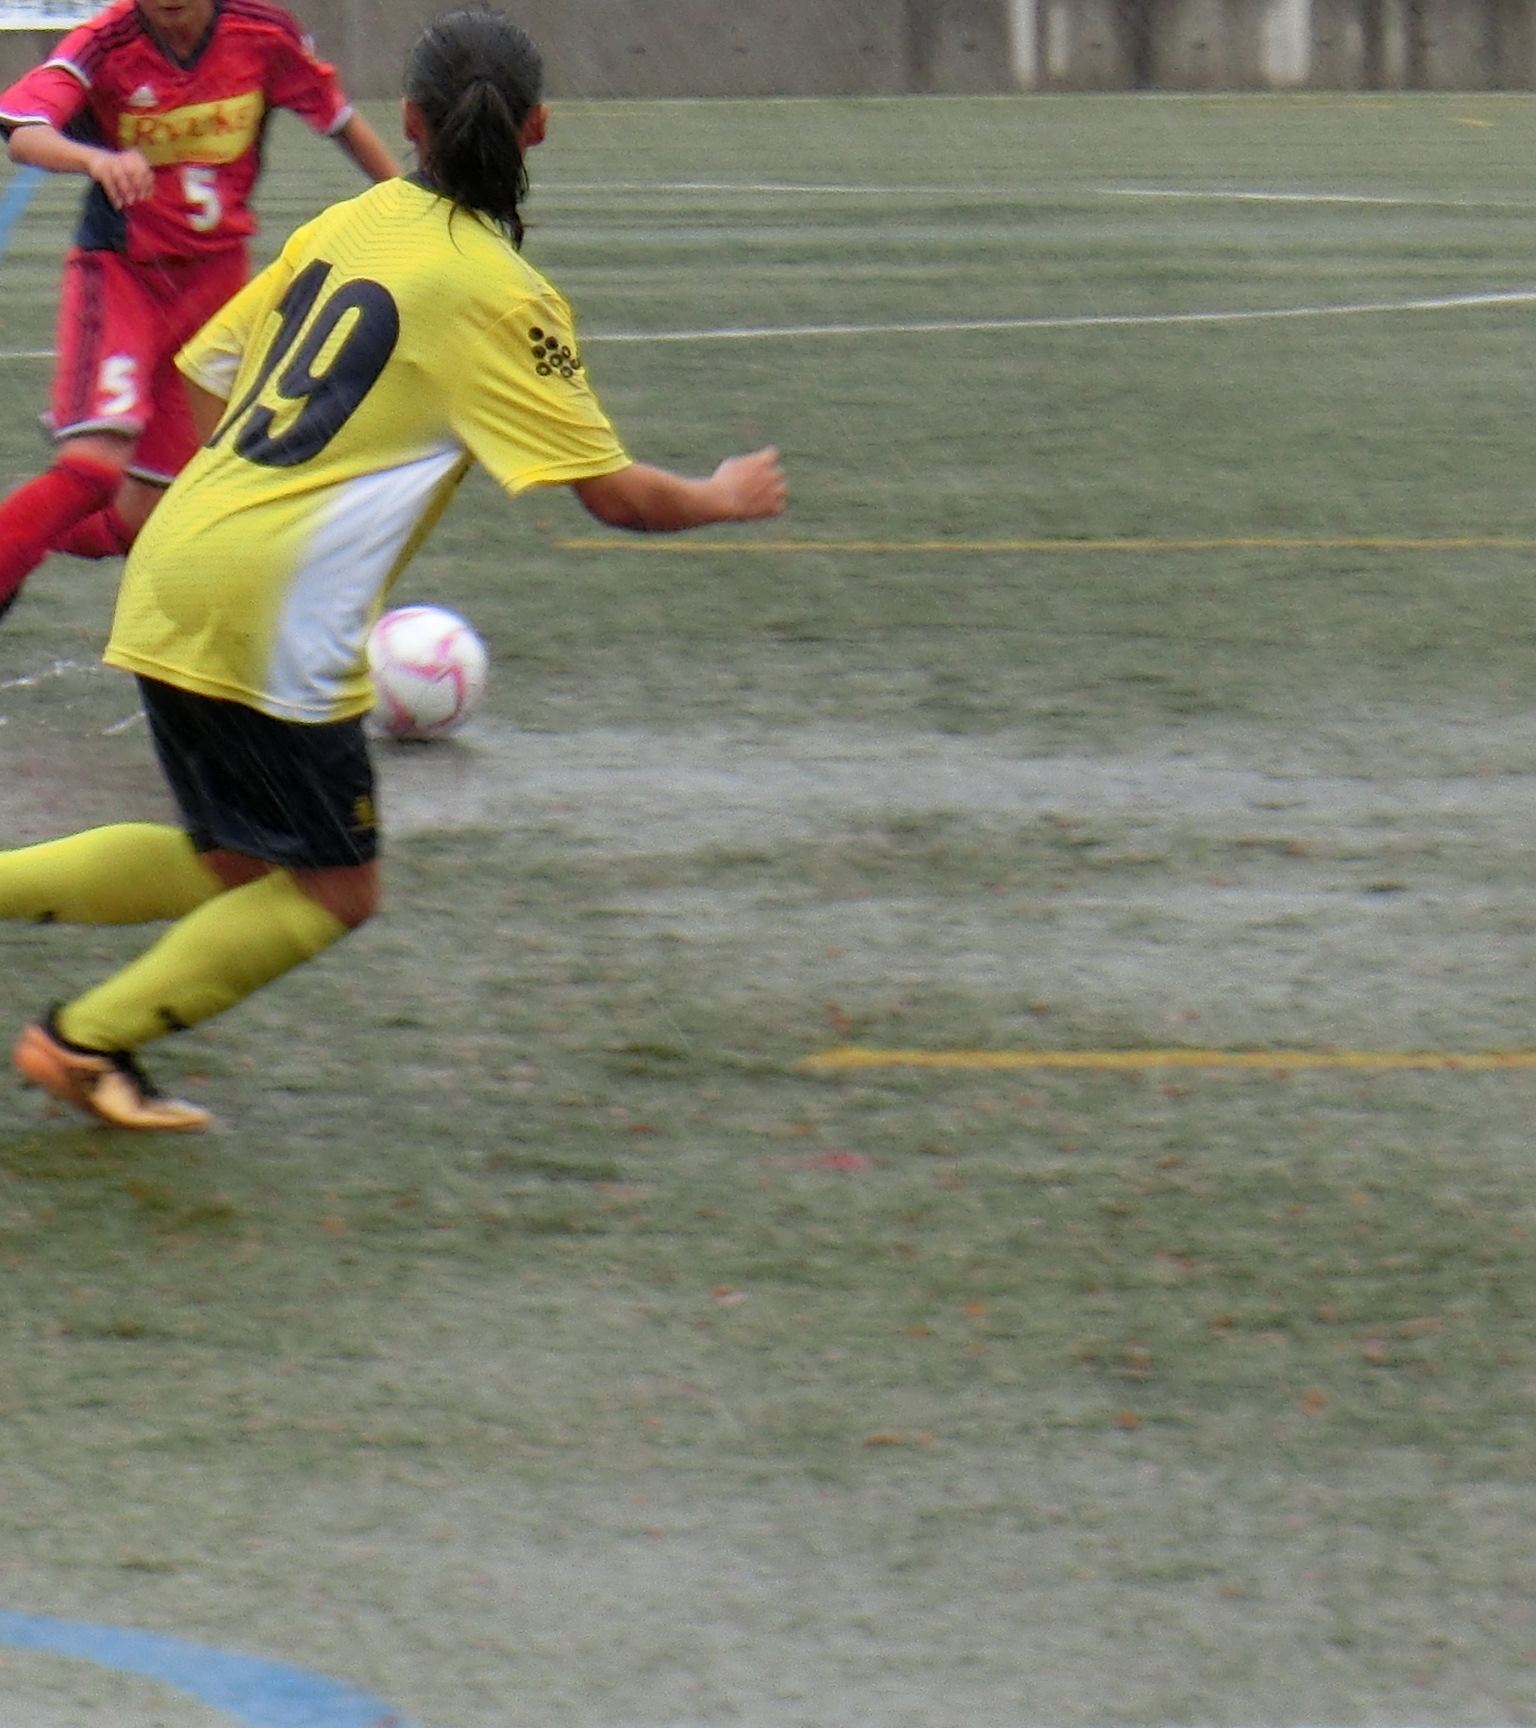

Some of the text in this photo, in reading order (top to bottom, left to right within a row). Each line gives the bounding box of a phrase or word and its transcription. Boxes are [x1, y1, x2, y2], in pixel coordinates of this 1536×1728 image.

[180, 166, 223, 232] 5
[98, 355, 141, 416] 5
[203, 258, 401, 468] 19
